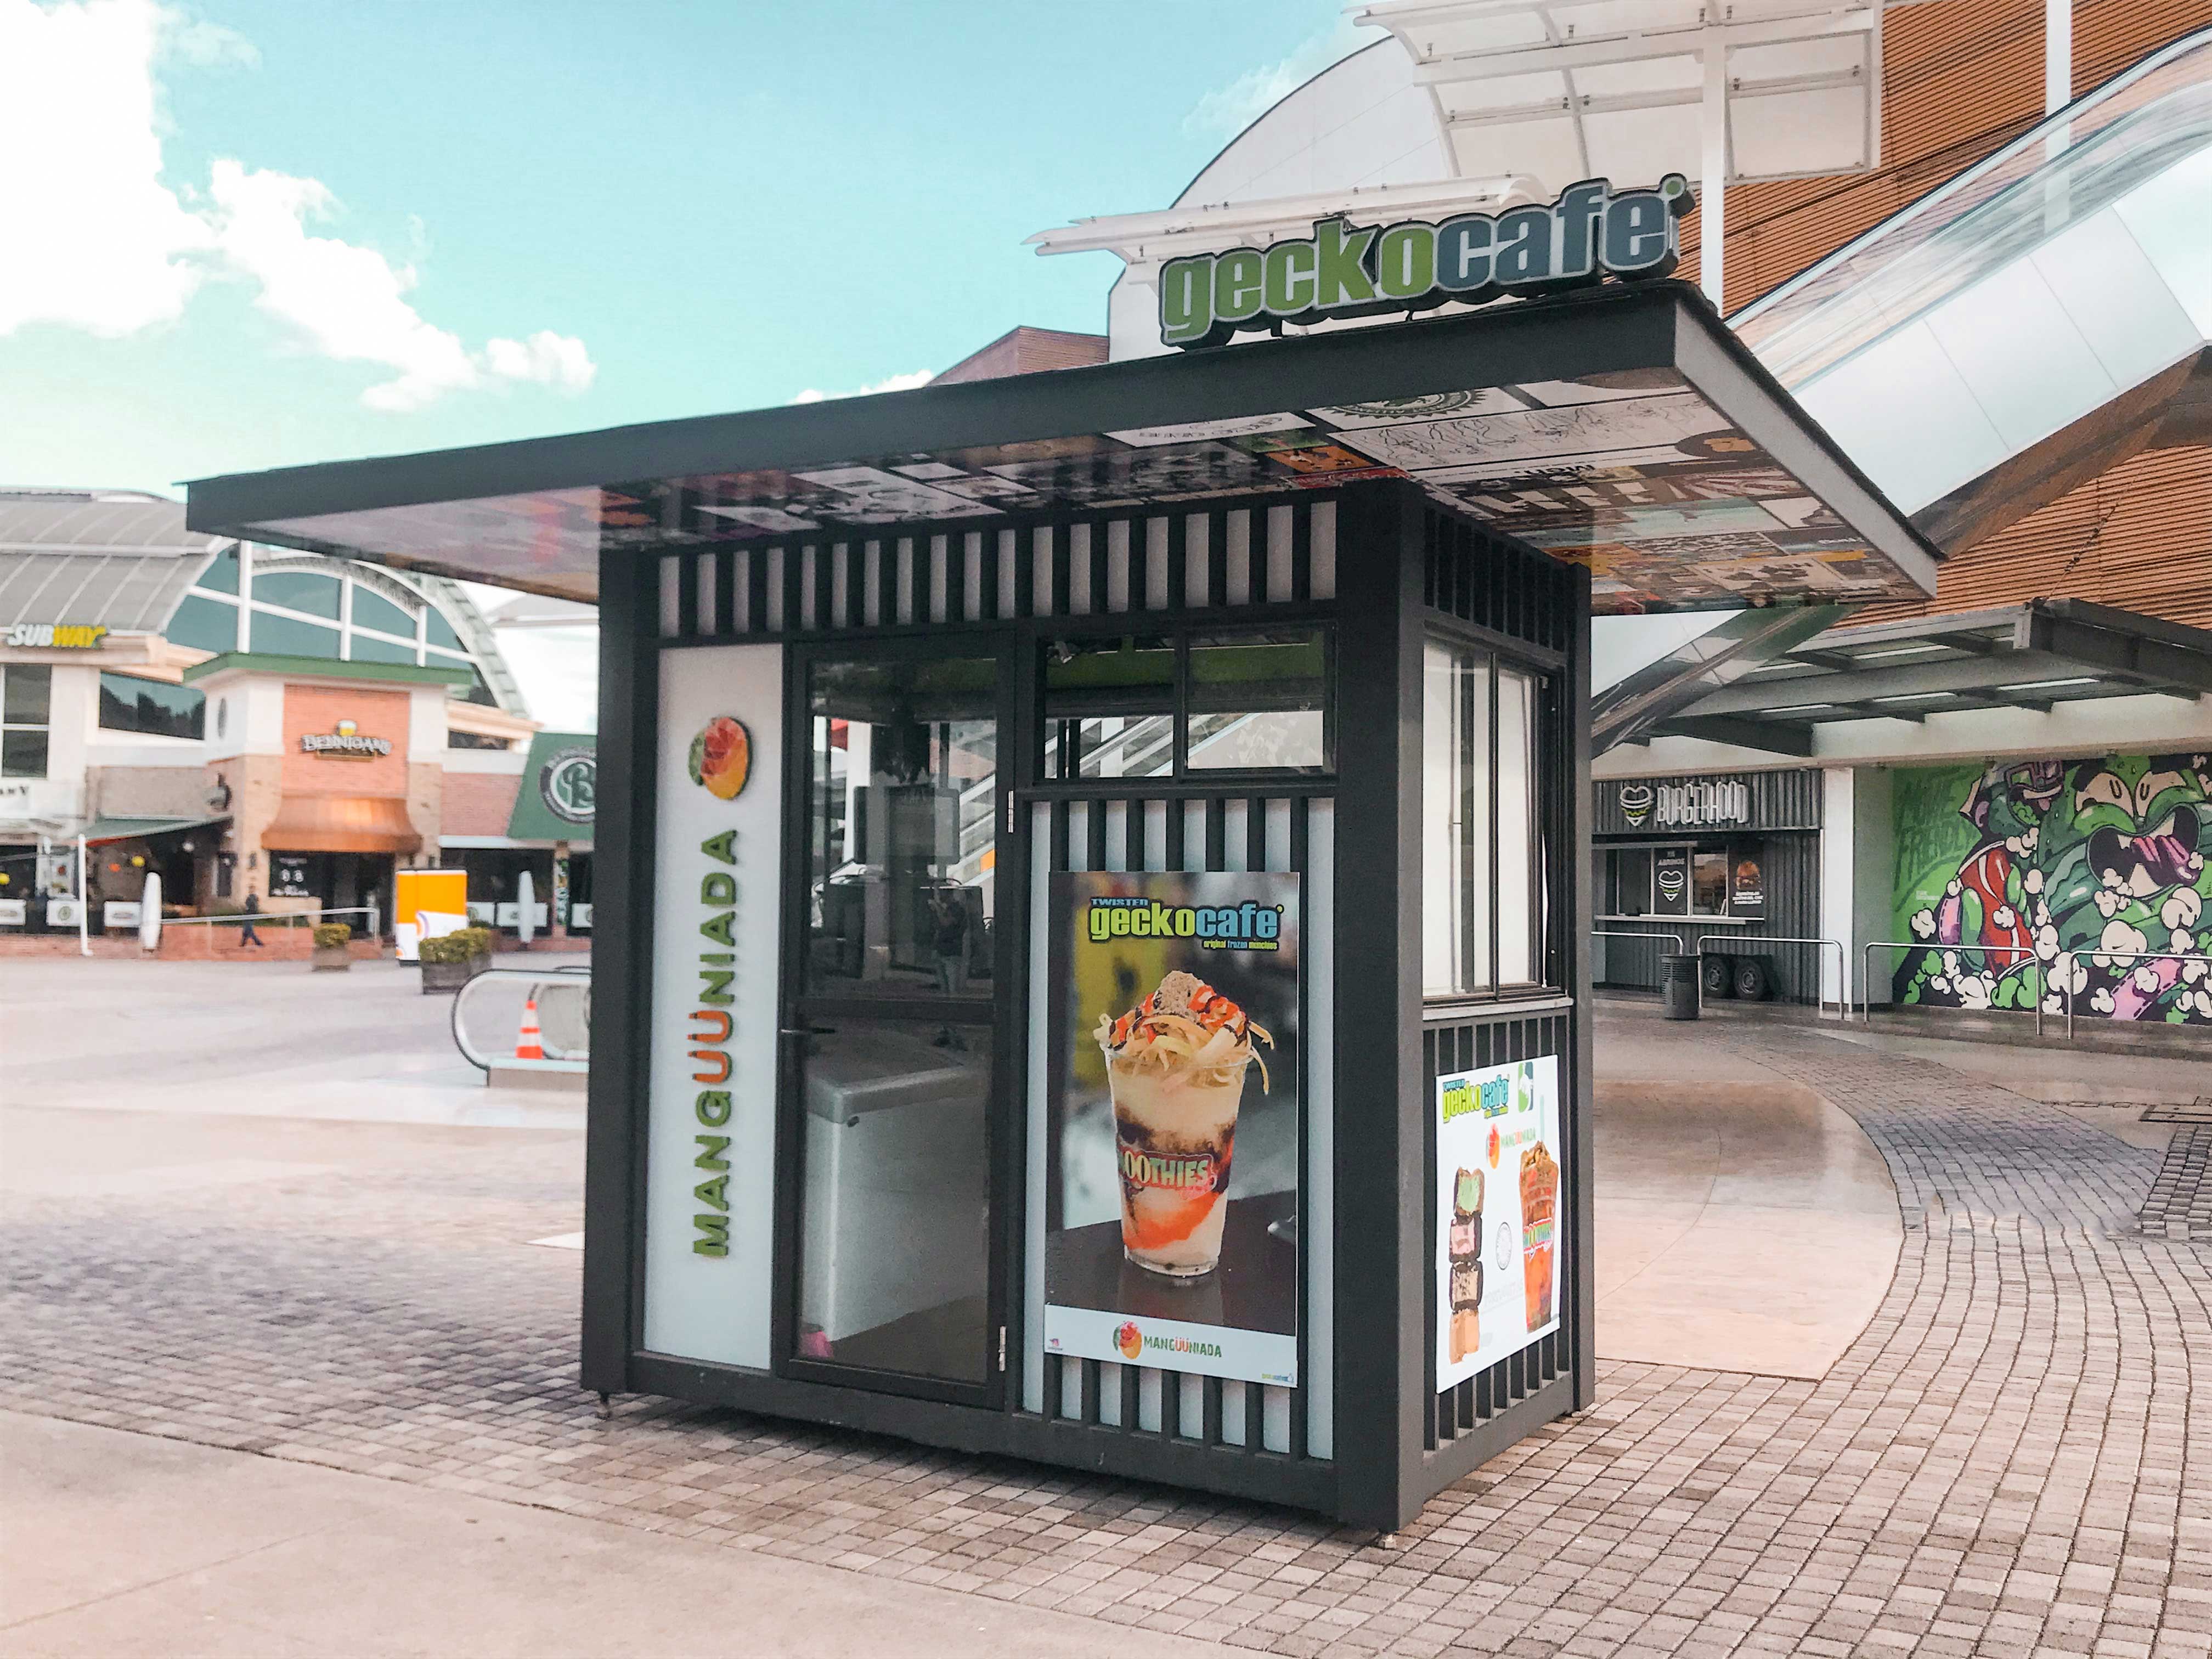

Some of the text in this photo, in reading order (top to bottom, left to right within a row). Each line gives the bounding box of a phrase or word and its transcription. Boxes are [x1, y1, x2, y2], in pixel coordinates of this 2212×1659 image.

[7, 623, 106, 648] SUBWAY
[1657, 781, 1749, 825] BURGERHOOD
[1119, 1150, 1209, 1187] OOTHIES
